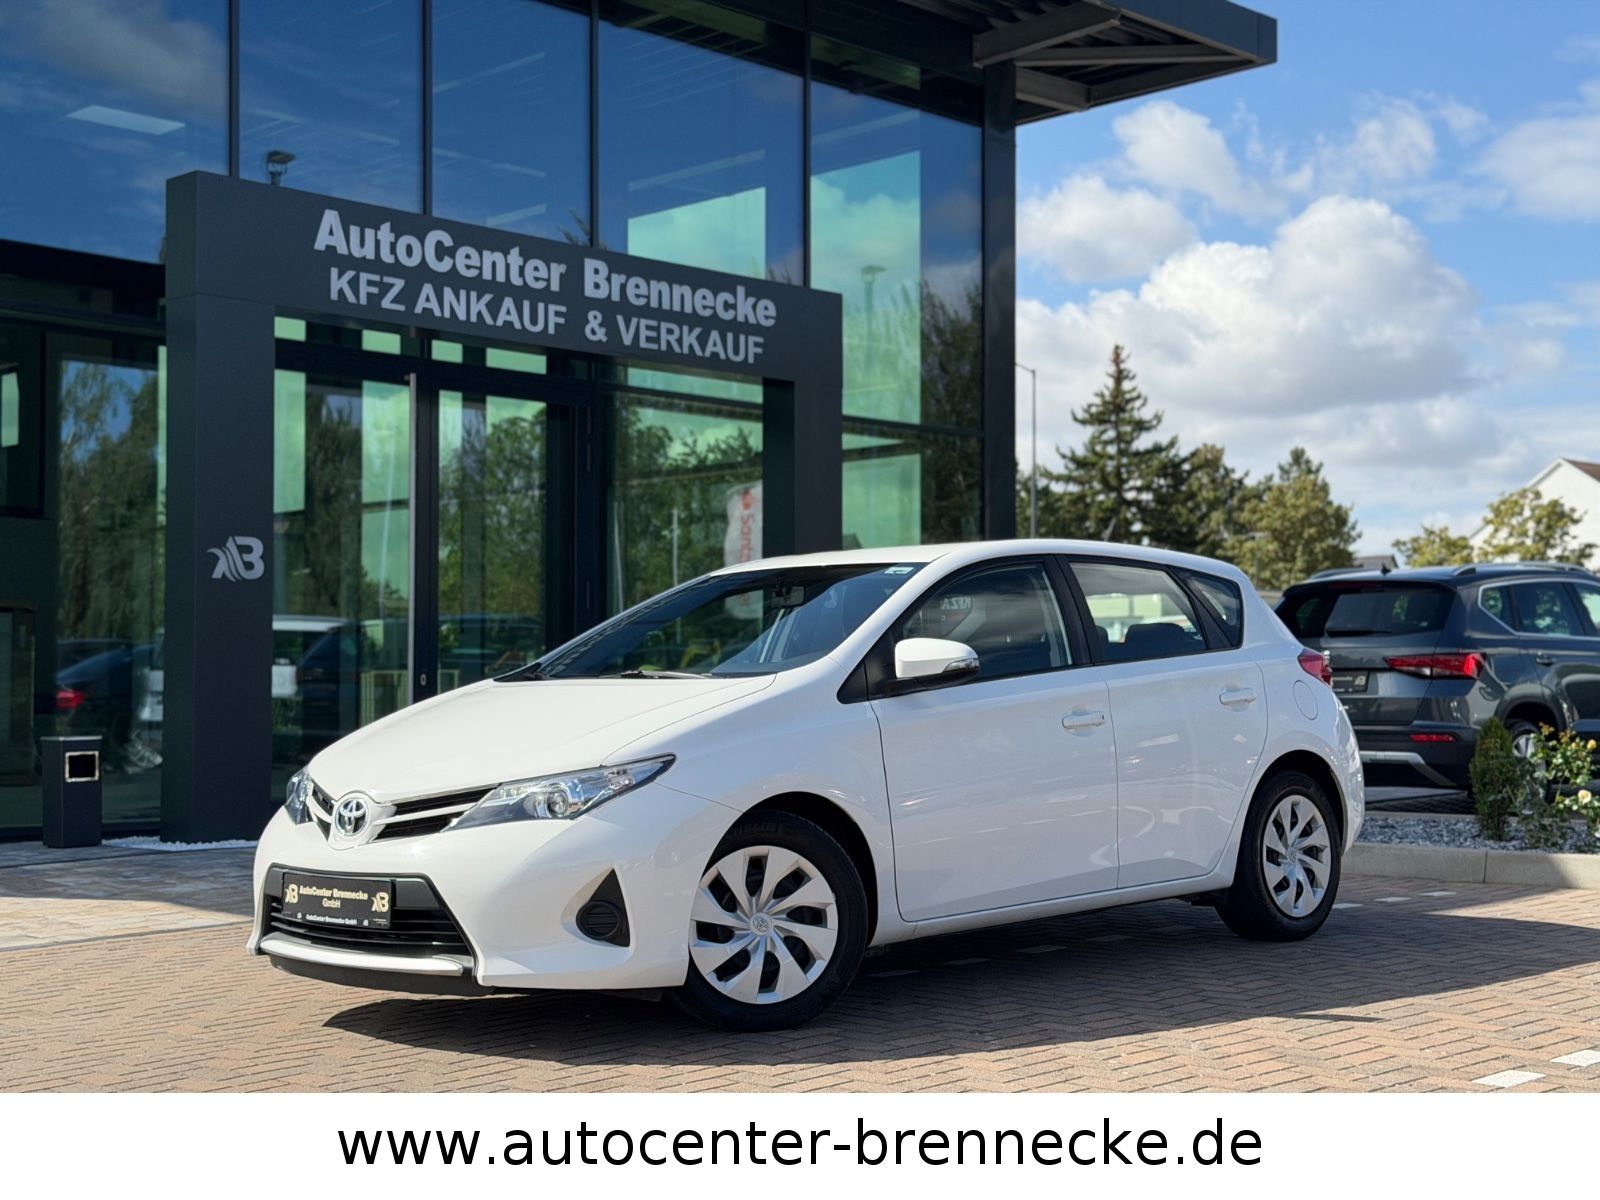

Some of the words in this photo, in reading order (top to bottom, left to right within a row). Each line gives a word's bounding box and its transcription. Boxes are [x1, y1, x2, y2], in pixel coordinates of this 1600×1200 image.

[314, 208, 567, 292] AutoCenter
[584, 257, 777, 327] Brennecke
[330, 267, 406, 311] KFZ
[414, 283, 567, 335] ANKAUF
[584, 310, 608, 343] &
[616, 314, 765, 364] VERKAUF
[299, 885, 332, 897] AutoCenter
[333, 888, 368, 900] Brennecke
[322, 898, 340, 908] GmbH
